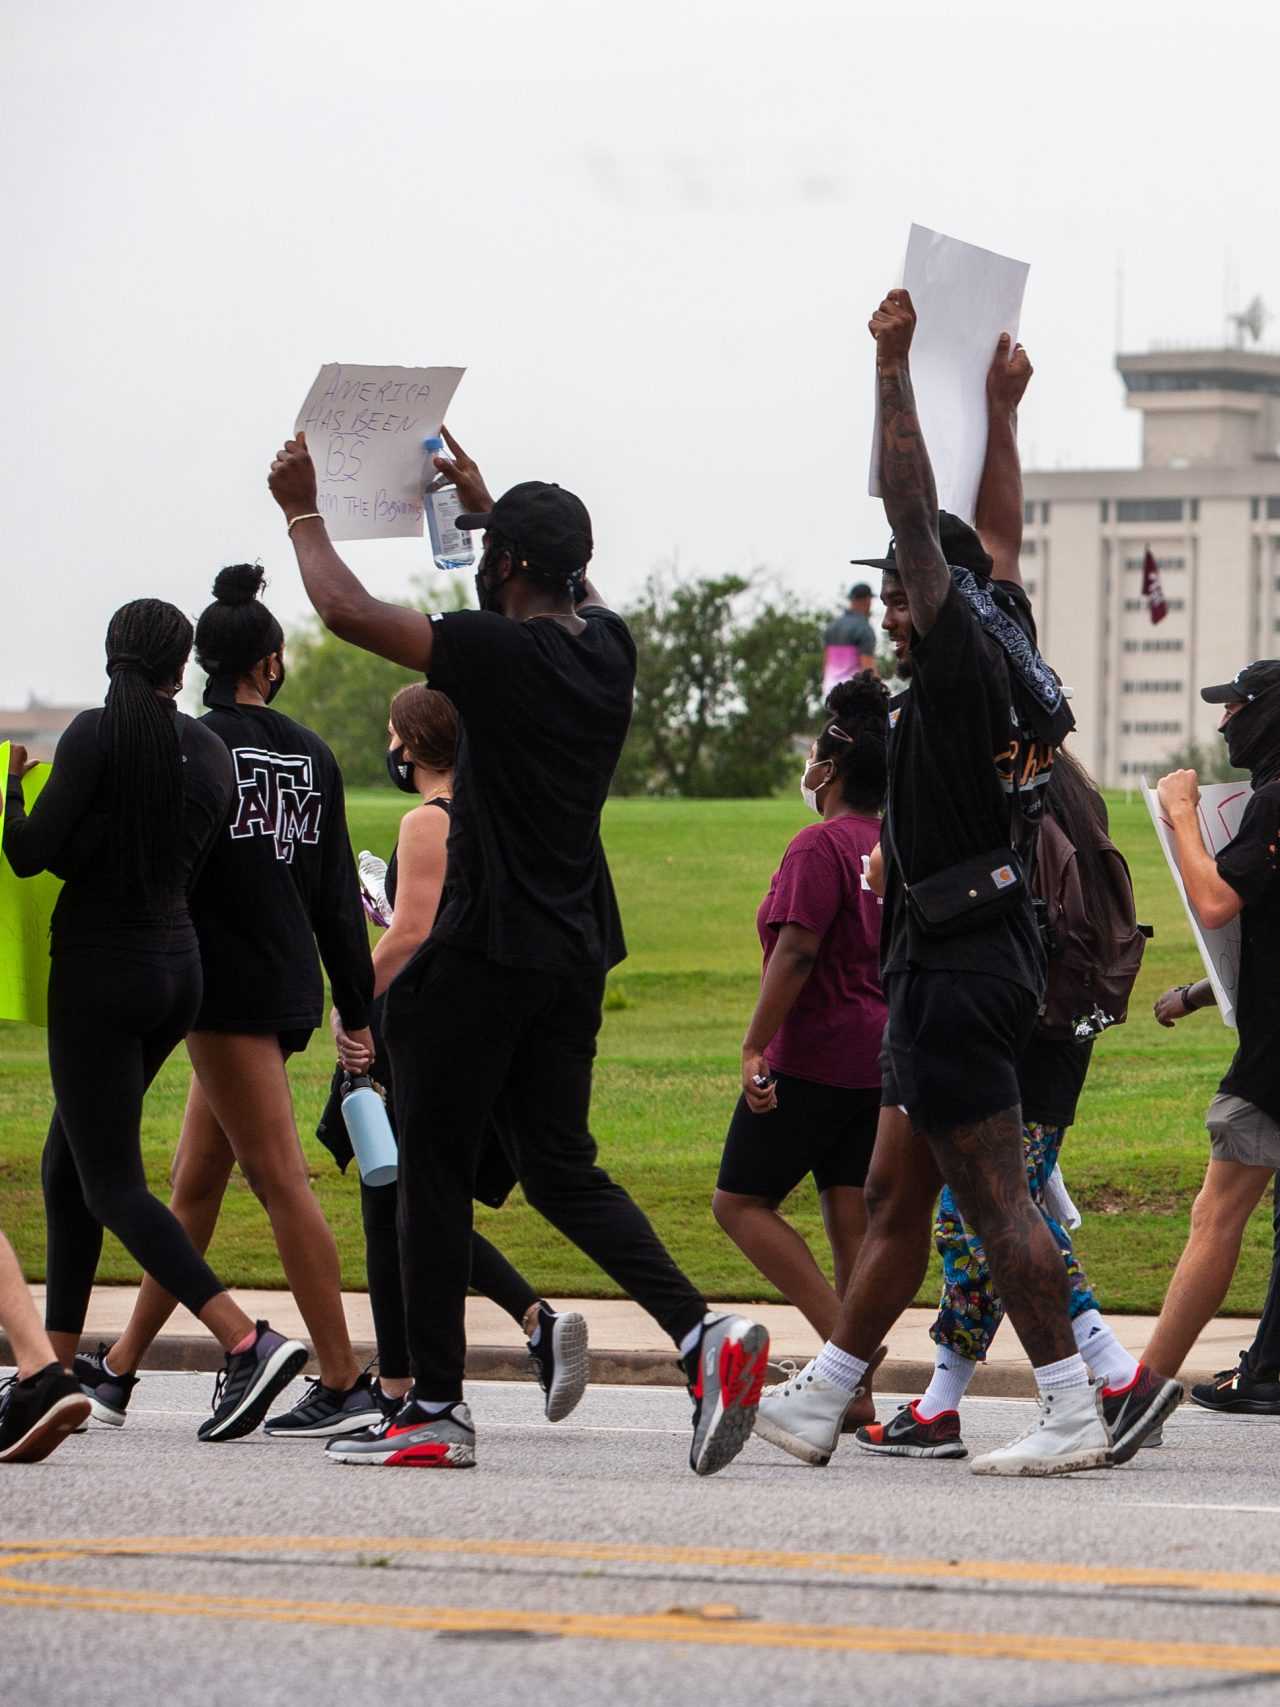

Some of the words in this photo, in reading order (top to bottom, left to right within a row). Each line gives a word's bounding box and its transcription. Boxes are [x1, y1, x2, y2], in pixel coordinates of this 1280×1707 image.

[321, 367, 432, 402] AMERICA
[304, 406, 345, 432] HAS
[351, 408, 418, 433] BEEN
[326, 434, 365, 478] BS
[343, 496, 369, 519] THE
